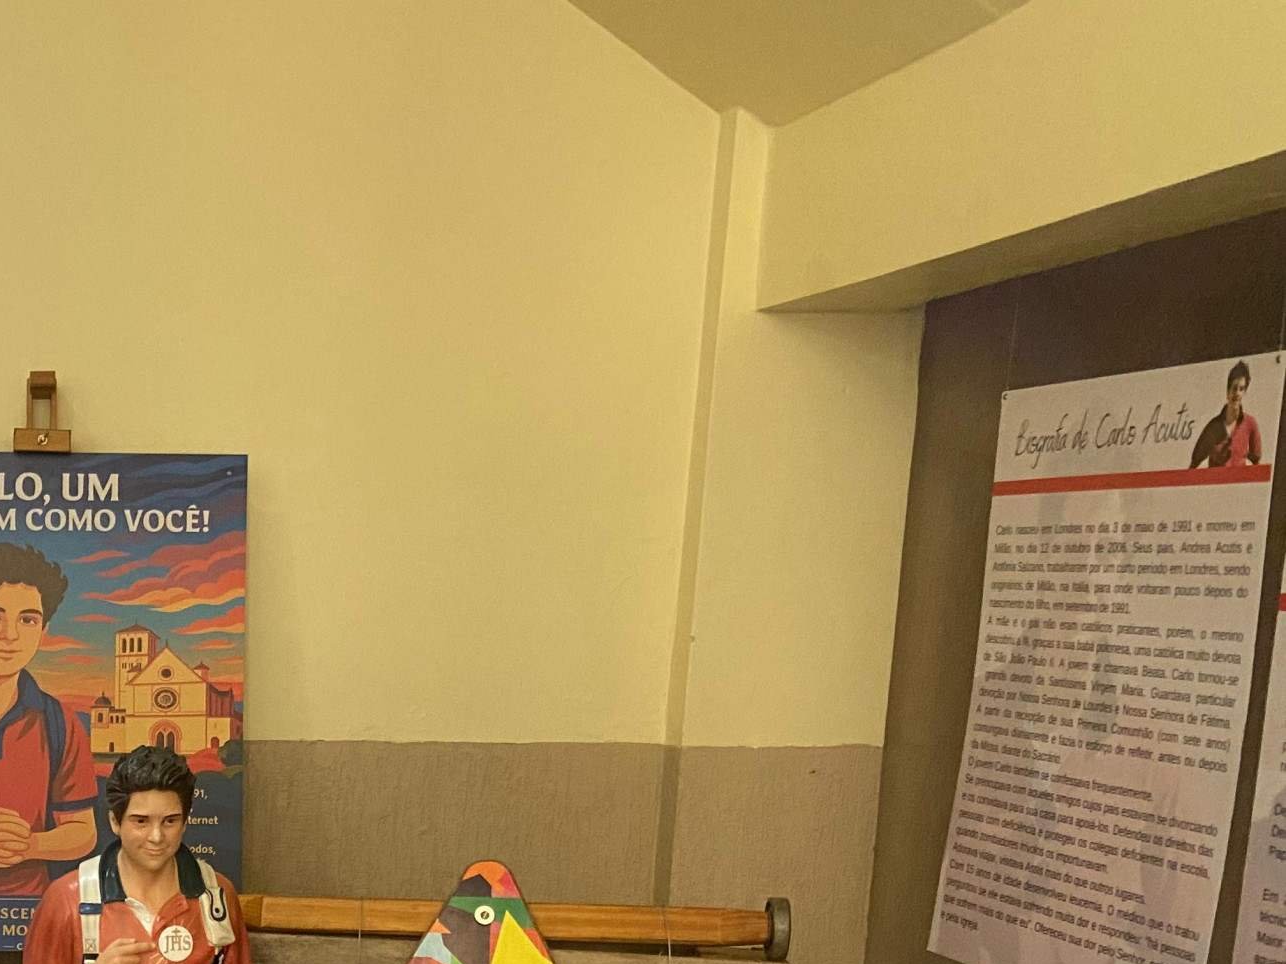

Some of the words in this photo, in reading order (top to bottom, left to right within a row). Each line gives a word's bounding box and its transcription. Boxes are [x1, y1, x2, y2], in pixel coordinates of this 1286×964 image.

[1015, 413, 1068, 469] Biografia
[1072, 408, 1088, 454] de
[1095, 406, 1137, 448] Carlo
[1142, 402, 1195, 444] Acutis
[62, 473, 120, 501] UM
[25, 508, 116, 532] COMO
[124, 504, 210, 532] VOCÊ!
[194, 789, 208, 799] 91,
[186, 816, 218, 824] ternet
[2, 924, 28, 936] MO
[164, 935, 191, 953] JHS
